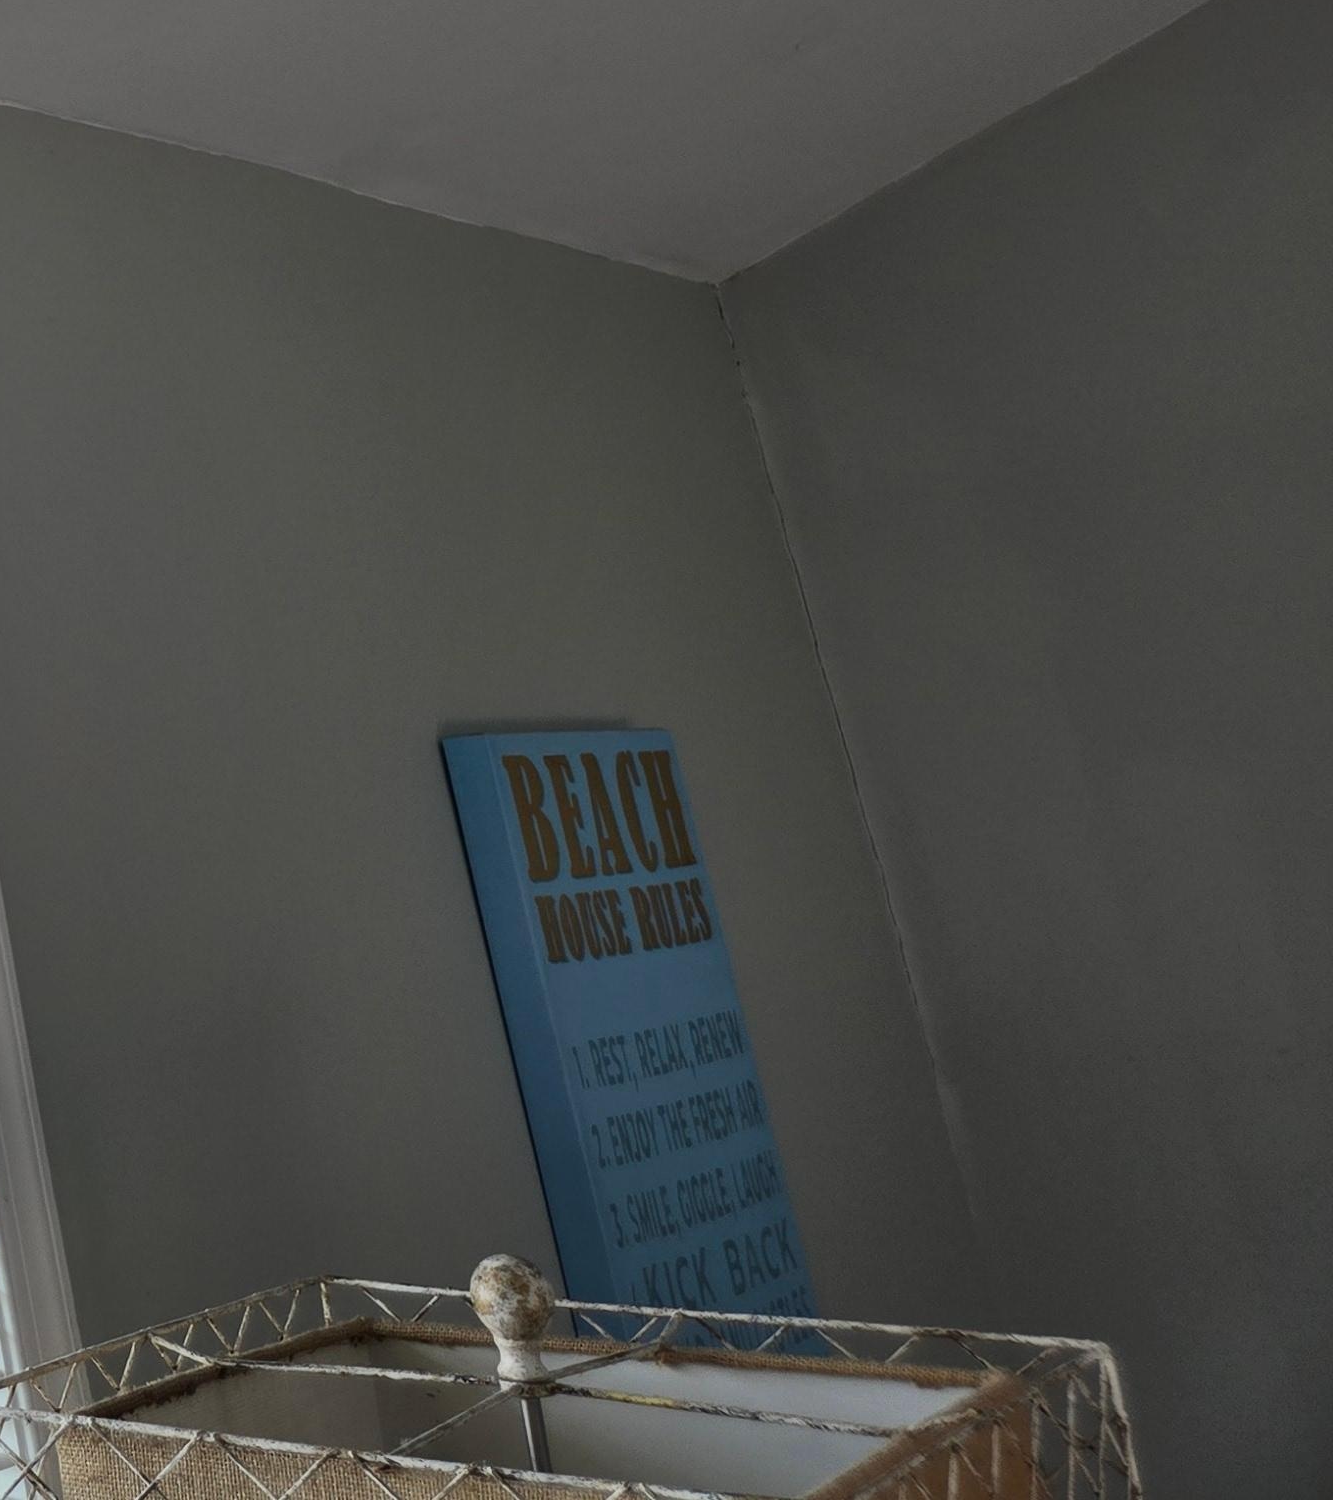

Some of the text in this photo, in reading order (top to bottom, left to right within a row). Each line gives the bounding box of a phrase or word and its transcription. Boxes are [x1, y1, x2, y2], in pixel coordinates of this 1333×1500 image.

[502, 750, 697, 882] BEACH
[535, 877, 712, 964] HOUSE RULES
[572, 1046, 590, 1088] 1.
[688, 1010, 744, 1066] RENEW
[591, 1079, 766, 1169] 2. ENJOY THE FRESH AIR
[643, 1247, 717, 1310] KICK
[723, 1217, 797, 1296] BACK
